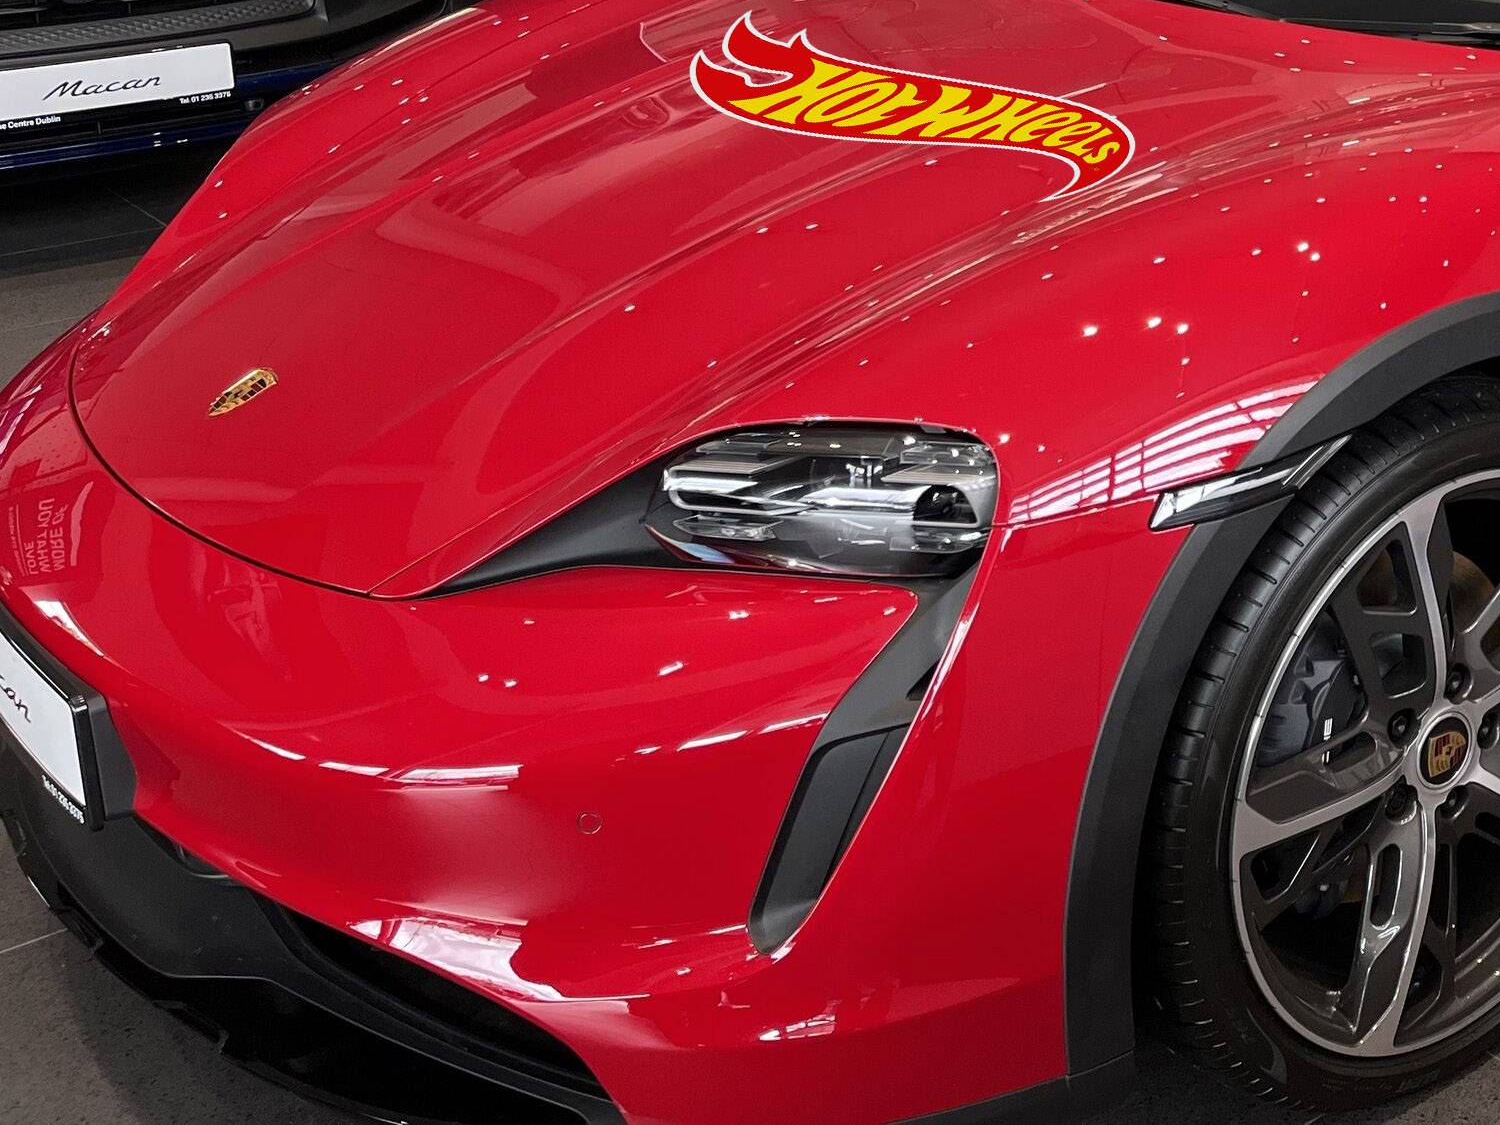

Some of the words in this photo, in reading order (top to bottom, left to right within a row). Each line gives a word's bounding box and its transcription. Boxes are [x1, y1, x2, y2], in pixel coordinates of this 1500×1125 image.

[41, 75, 161, 101] Macan
[8, 119, 35, 129] Centre
[35, 115, 61, 125] Dublin
